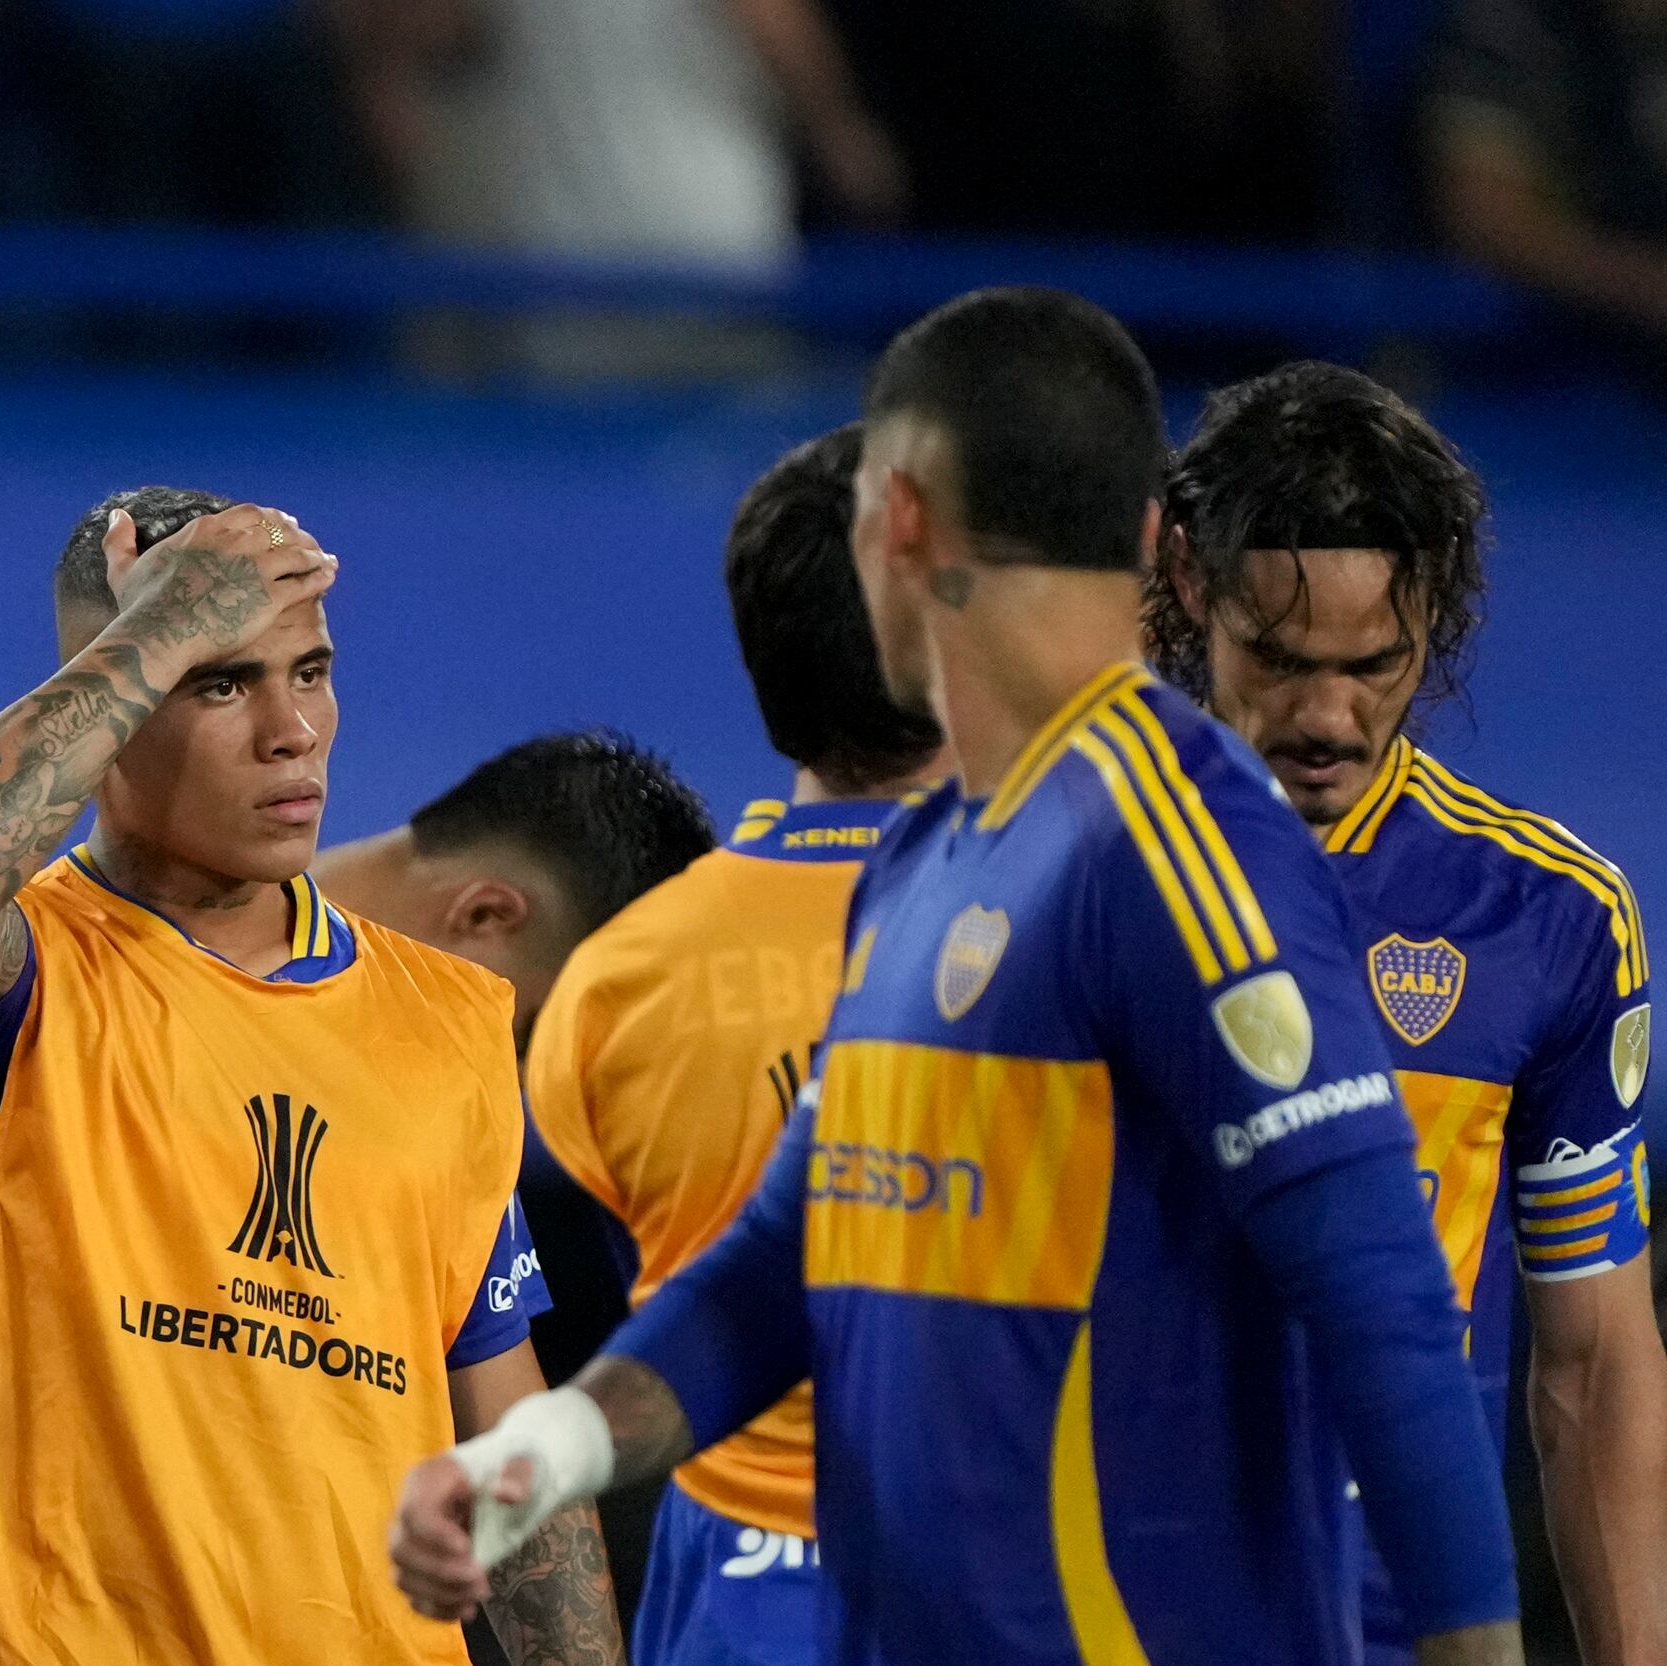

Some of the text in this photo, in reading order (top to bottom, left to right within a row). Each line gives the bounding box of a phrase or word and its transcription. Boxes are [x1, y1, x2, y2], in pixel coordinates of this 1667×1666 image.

[40, 689, 112, 758] Stella
[1382, 970, 1453, 996] CABJ
[119, 1294, 407, 1396] LIBERTADORES
